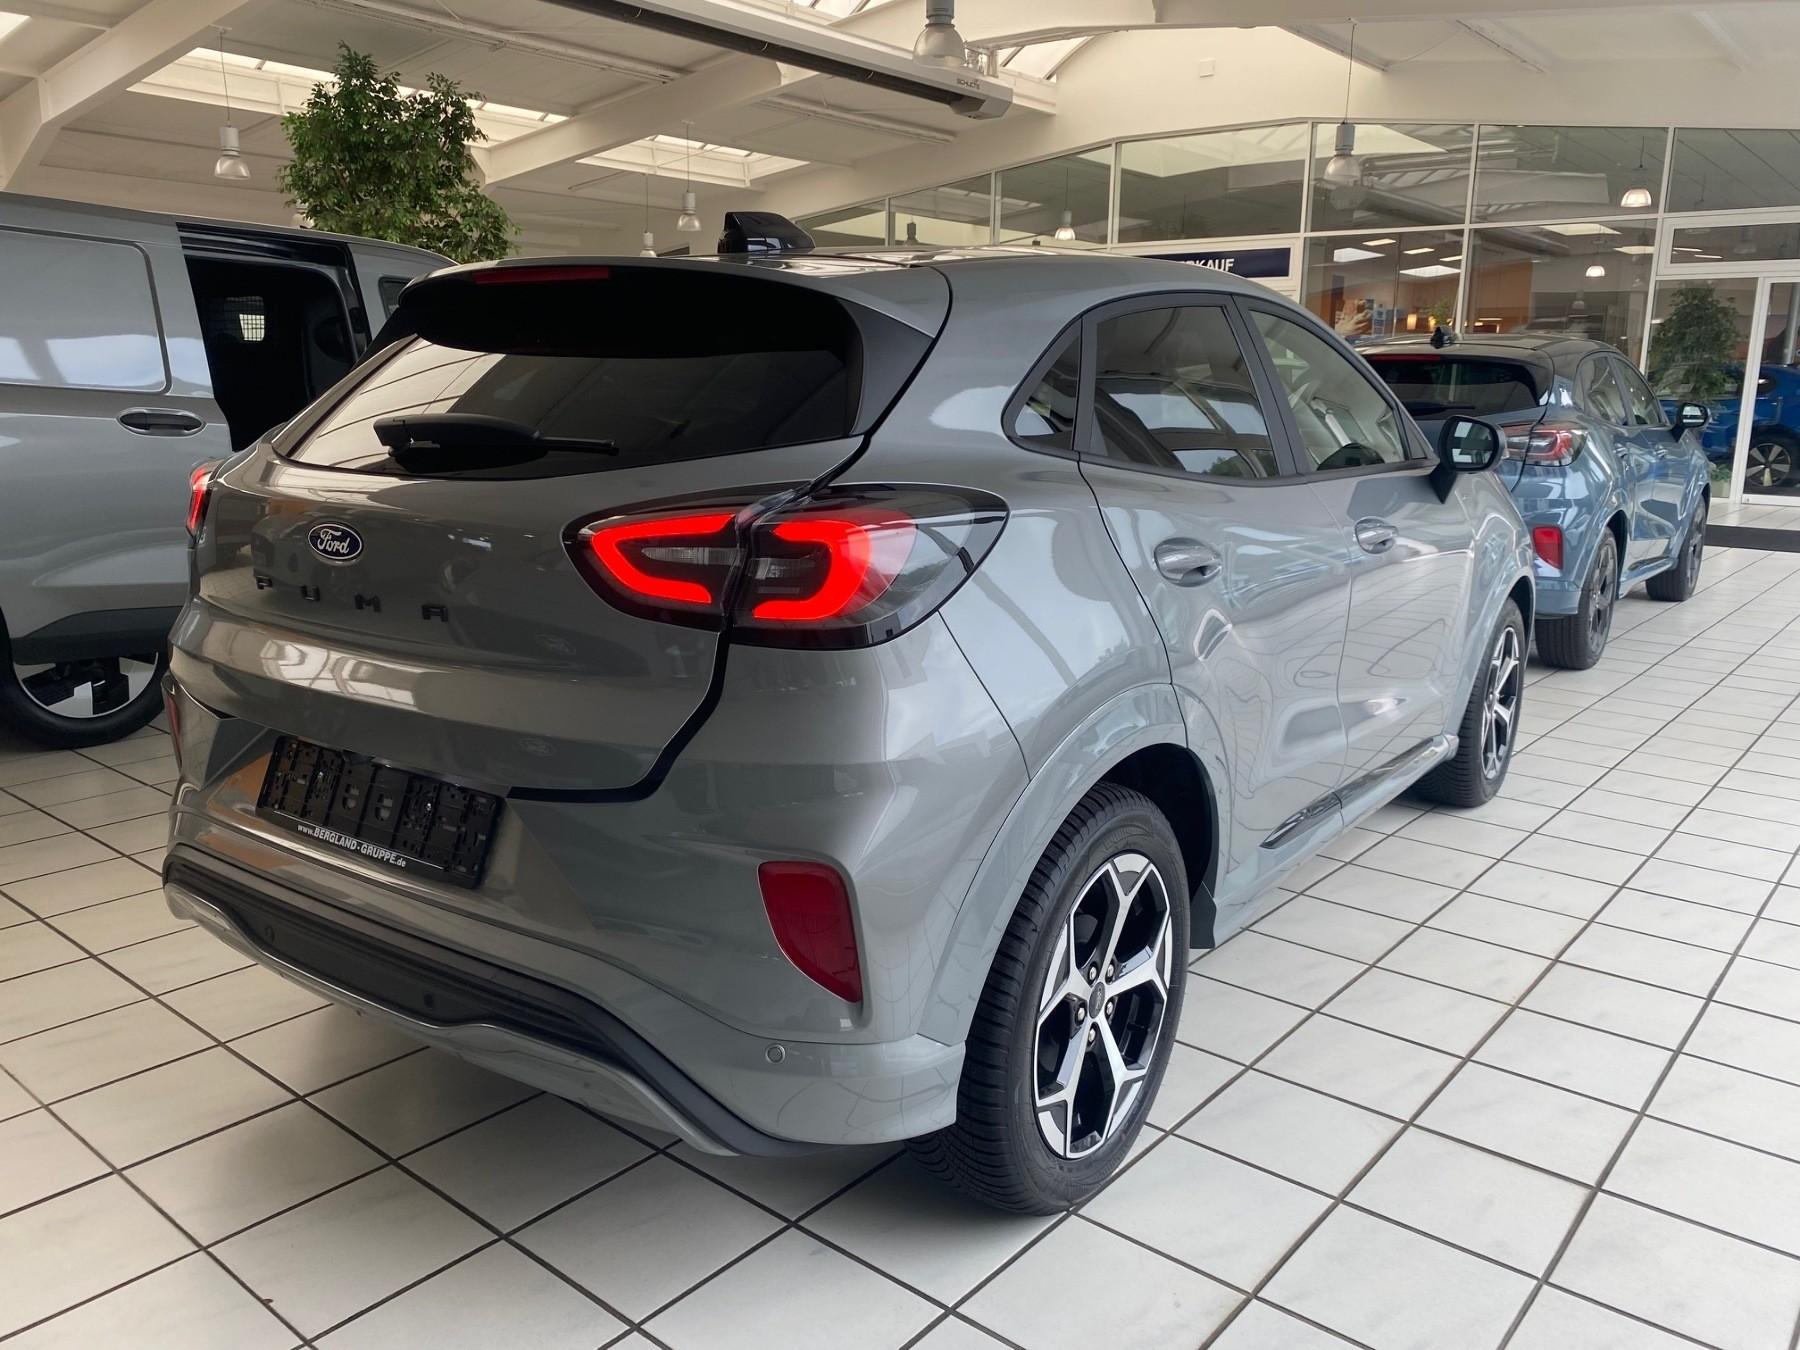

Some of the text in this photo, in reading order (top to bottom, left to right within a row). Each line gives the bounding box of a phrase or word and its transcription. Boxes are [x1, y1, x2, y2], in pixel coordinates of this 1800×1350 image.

[1184, 258, 1234, 272] KAUF
[317, 528, 350, 553] Ford
[256, 575, 448, 622] PUMA
